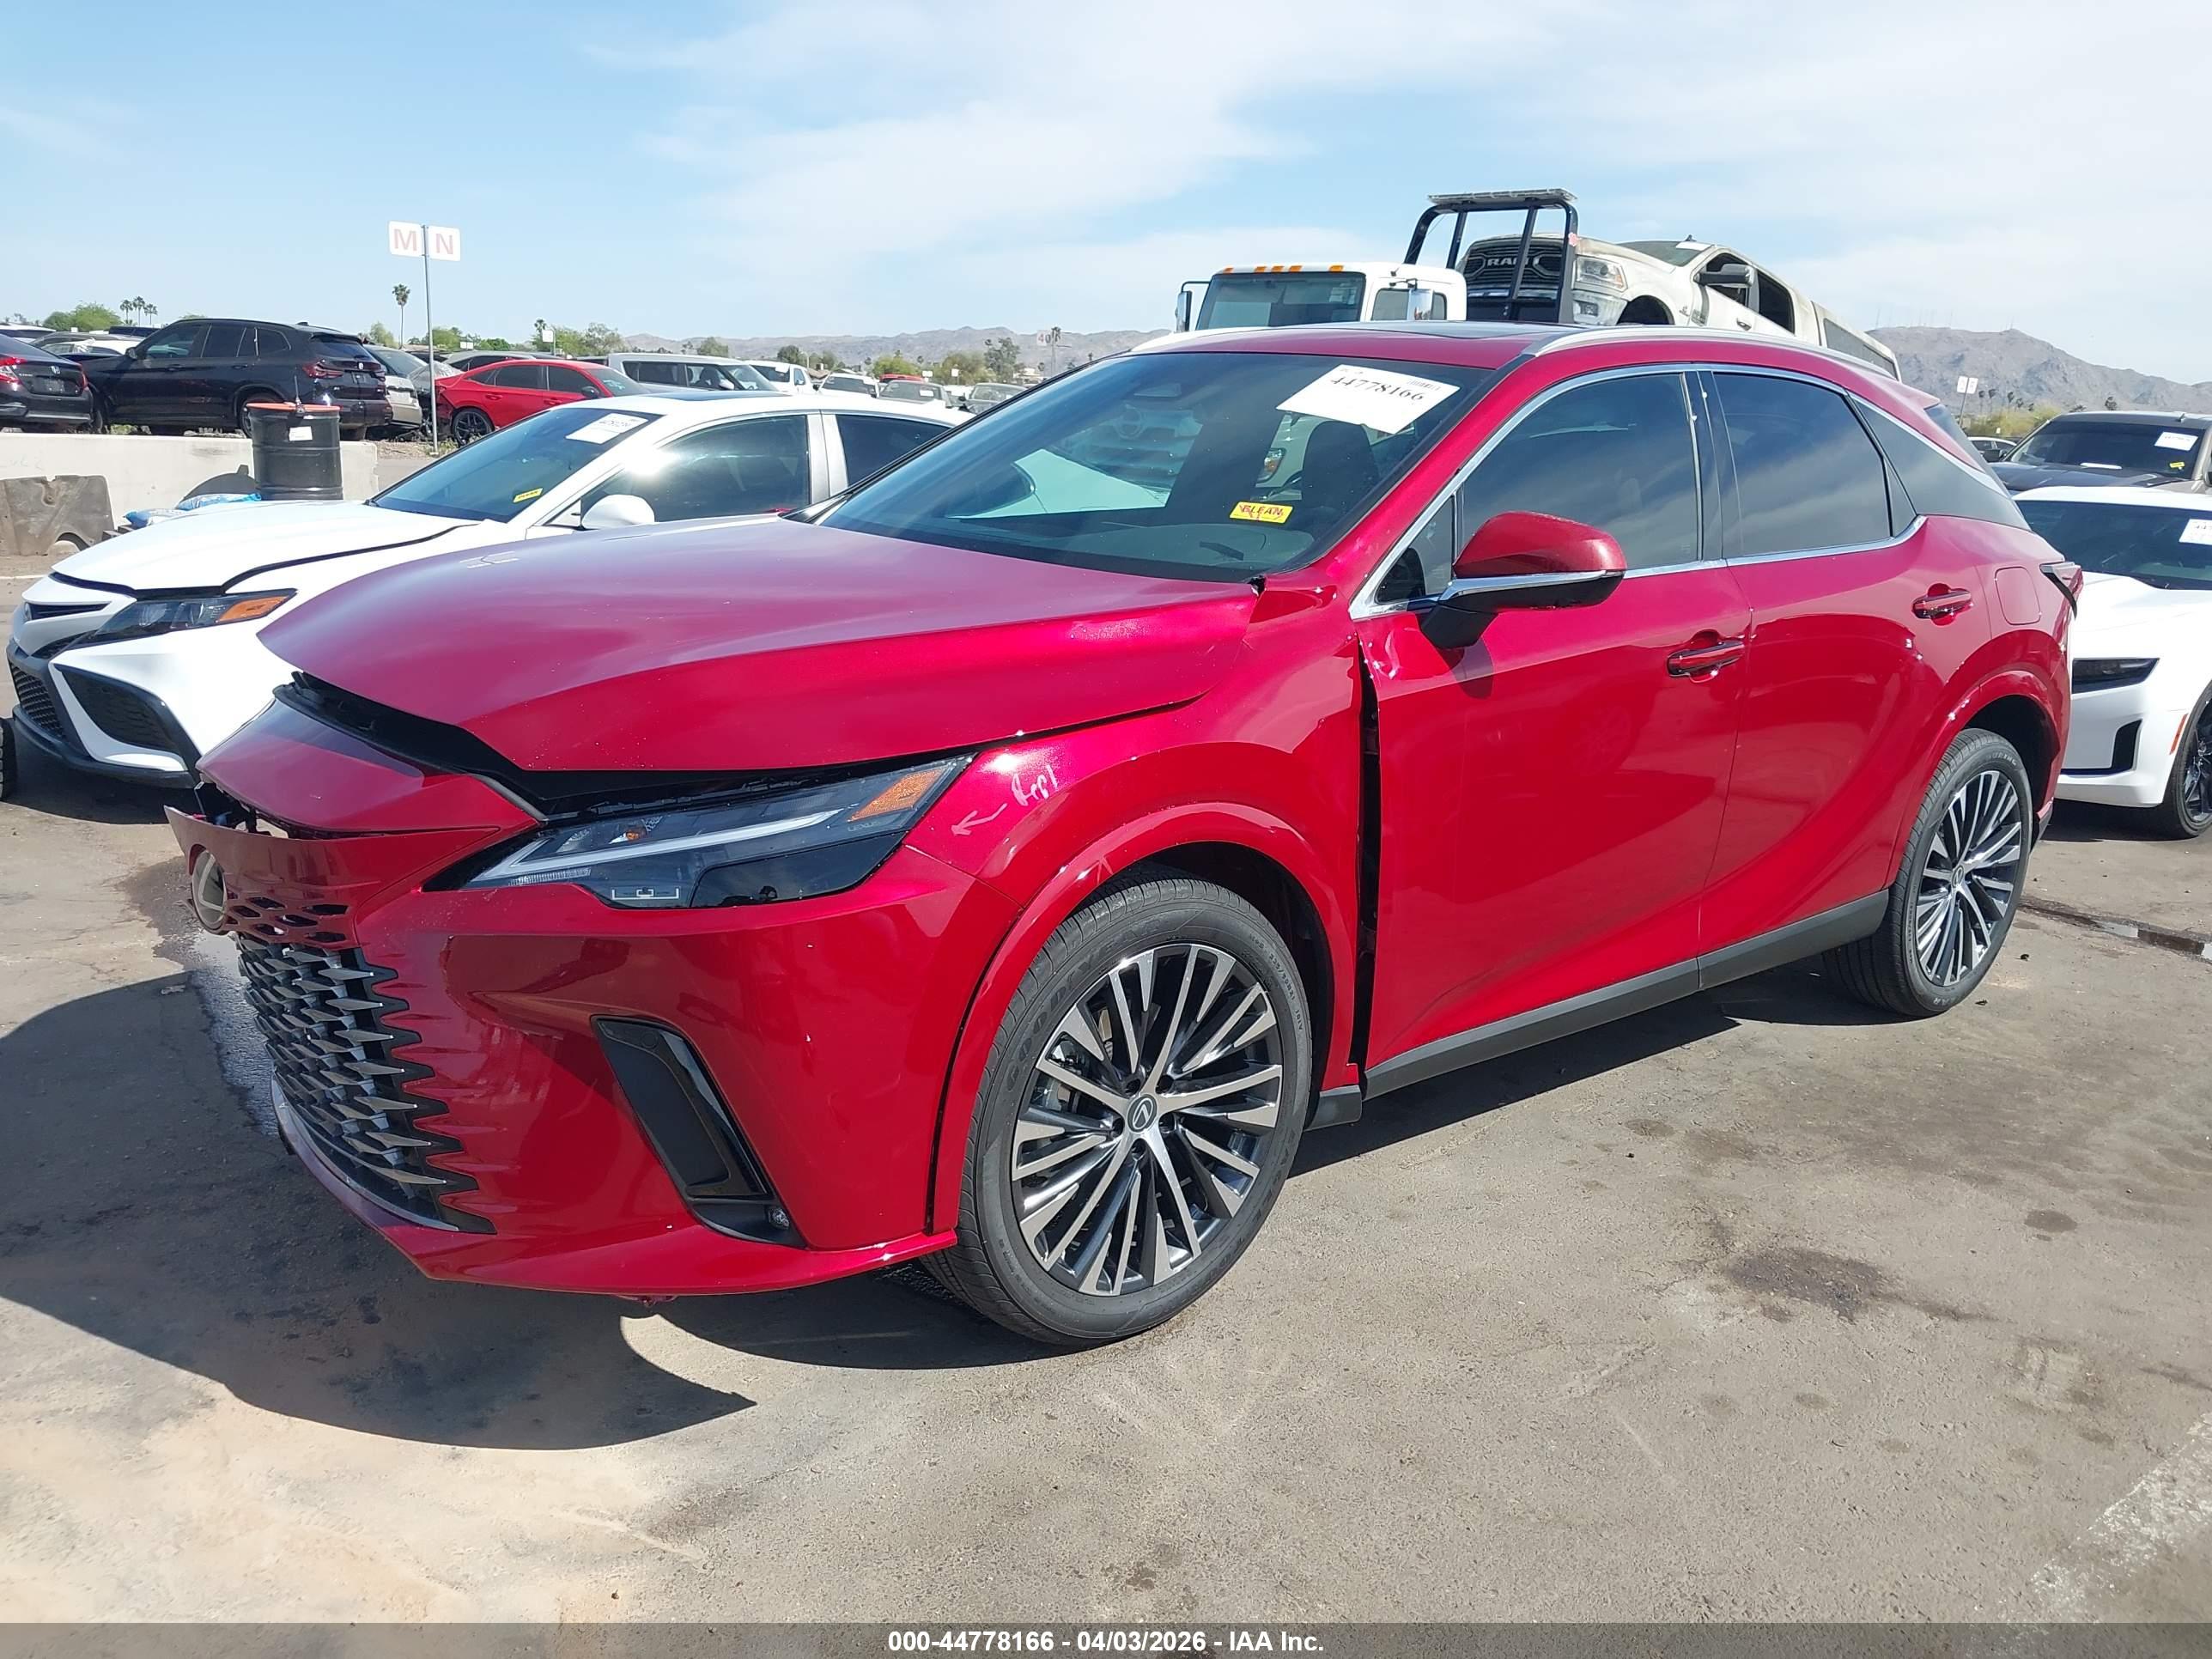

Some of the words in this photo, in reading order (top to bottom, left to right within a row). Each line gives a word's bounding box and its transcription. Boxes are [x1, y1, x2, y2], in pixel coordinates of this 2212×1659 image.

[394, 228, 417, 251] M
[435, 234, 453, 254] N
[1330, 375, 1424, 401] 44778166
